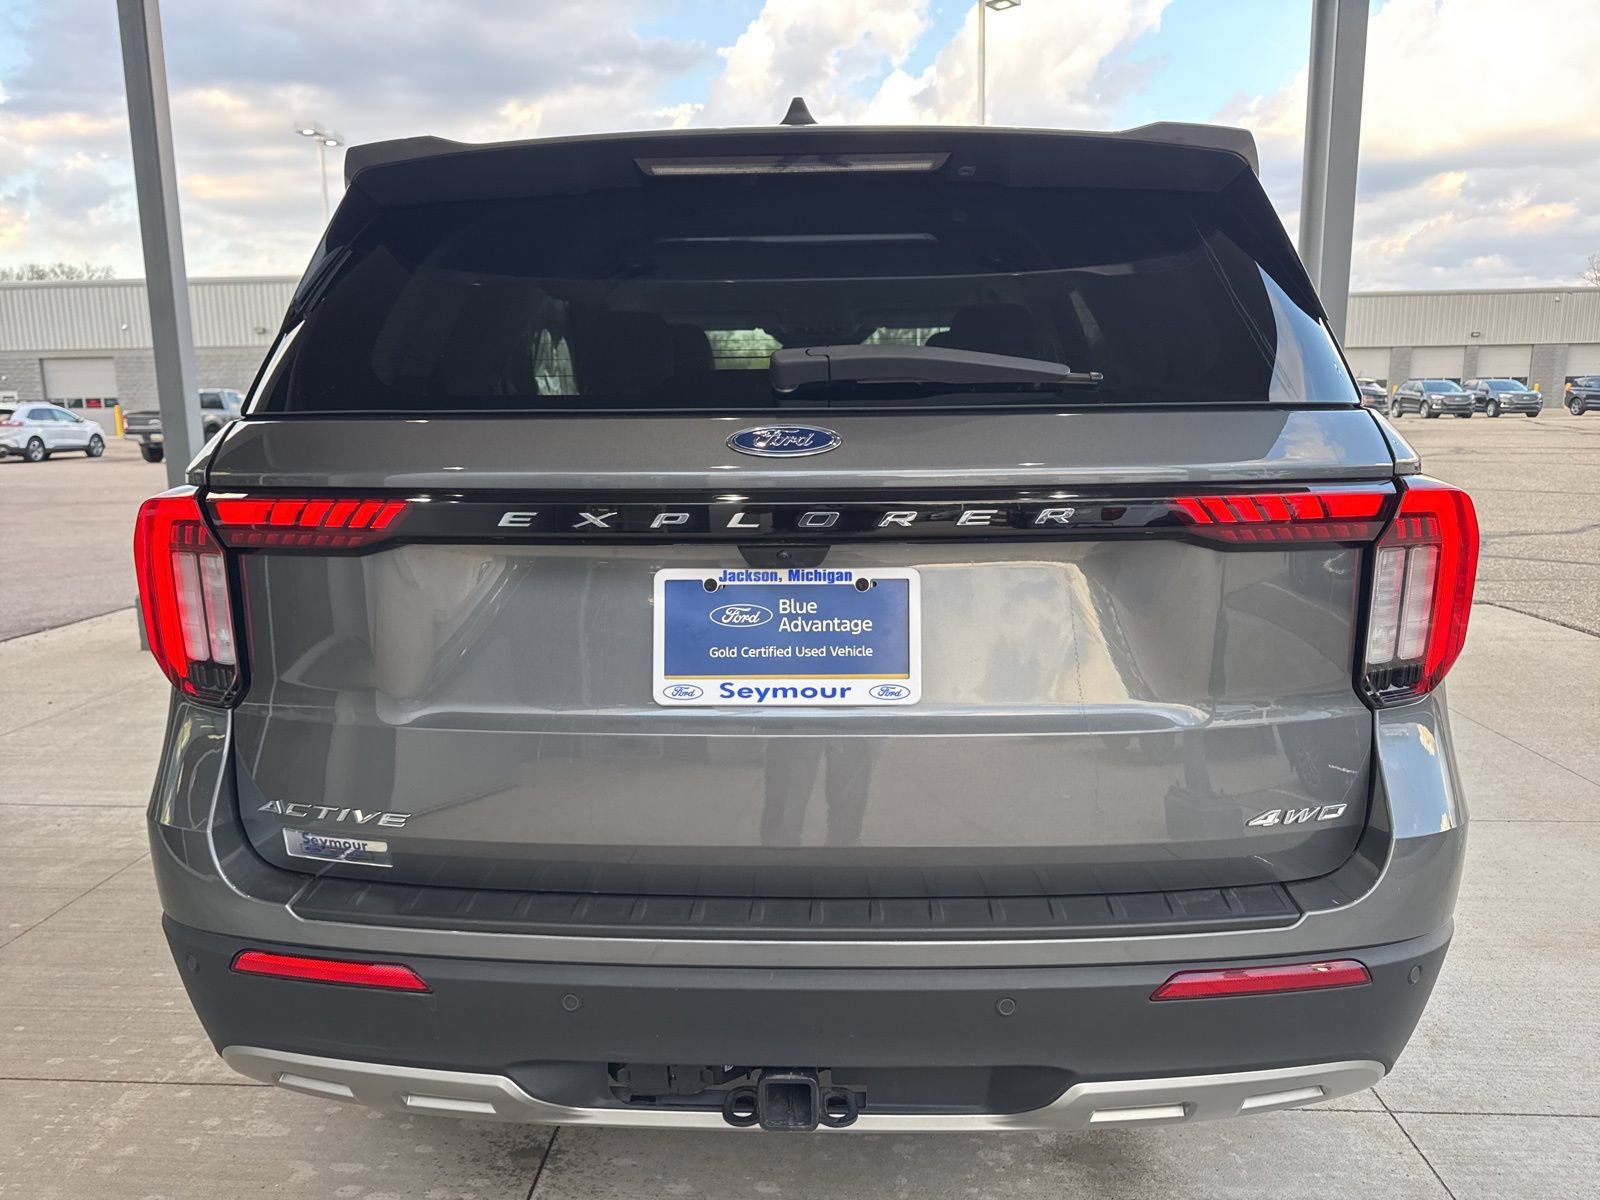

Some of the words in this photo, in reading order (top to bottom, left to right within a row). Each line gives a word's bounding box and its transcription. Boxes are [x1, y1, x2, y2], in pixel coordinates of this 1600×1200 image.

[753, 427, 815, 448] Ford
[497, 506, 1076, 529] EXPLORER
[718, 569, 783, 584] Jackson,
[787, 569, 853, 584] Michigan
[721, 606, 761, 624] Ford
[778, 599, 818, 615] Blue
[778, 617, 873, 635] Advantage
[709, 646, 738, 658] Gold
[741, 646, 792, 658] Certified
[796, 645, 826, 657] Used
[830, 645, 873, 657] Vehicle
[719, 681, 852, 703] Seymour
[256, 799, 412, 828] ACTIVE
[1246, 803, 1348, 827] 4WD
[302, 831, 369, 852] Seymour
